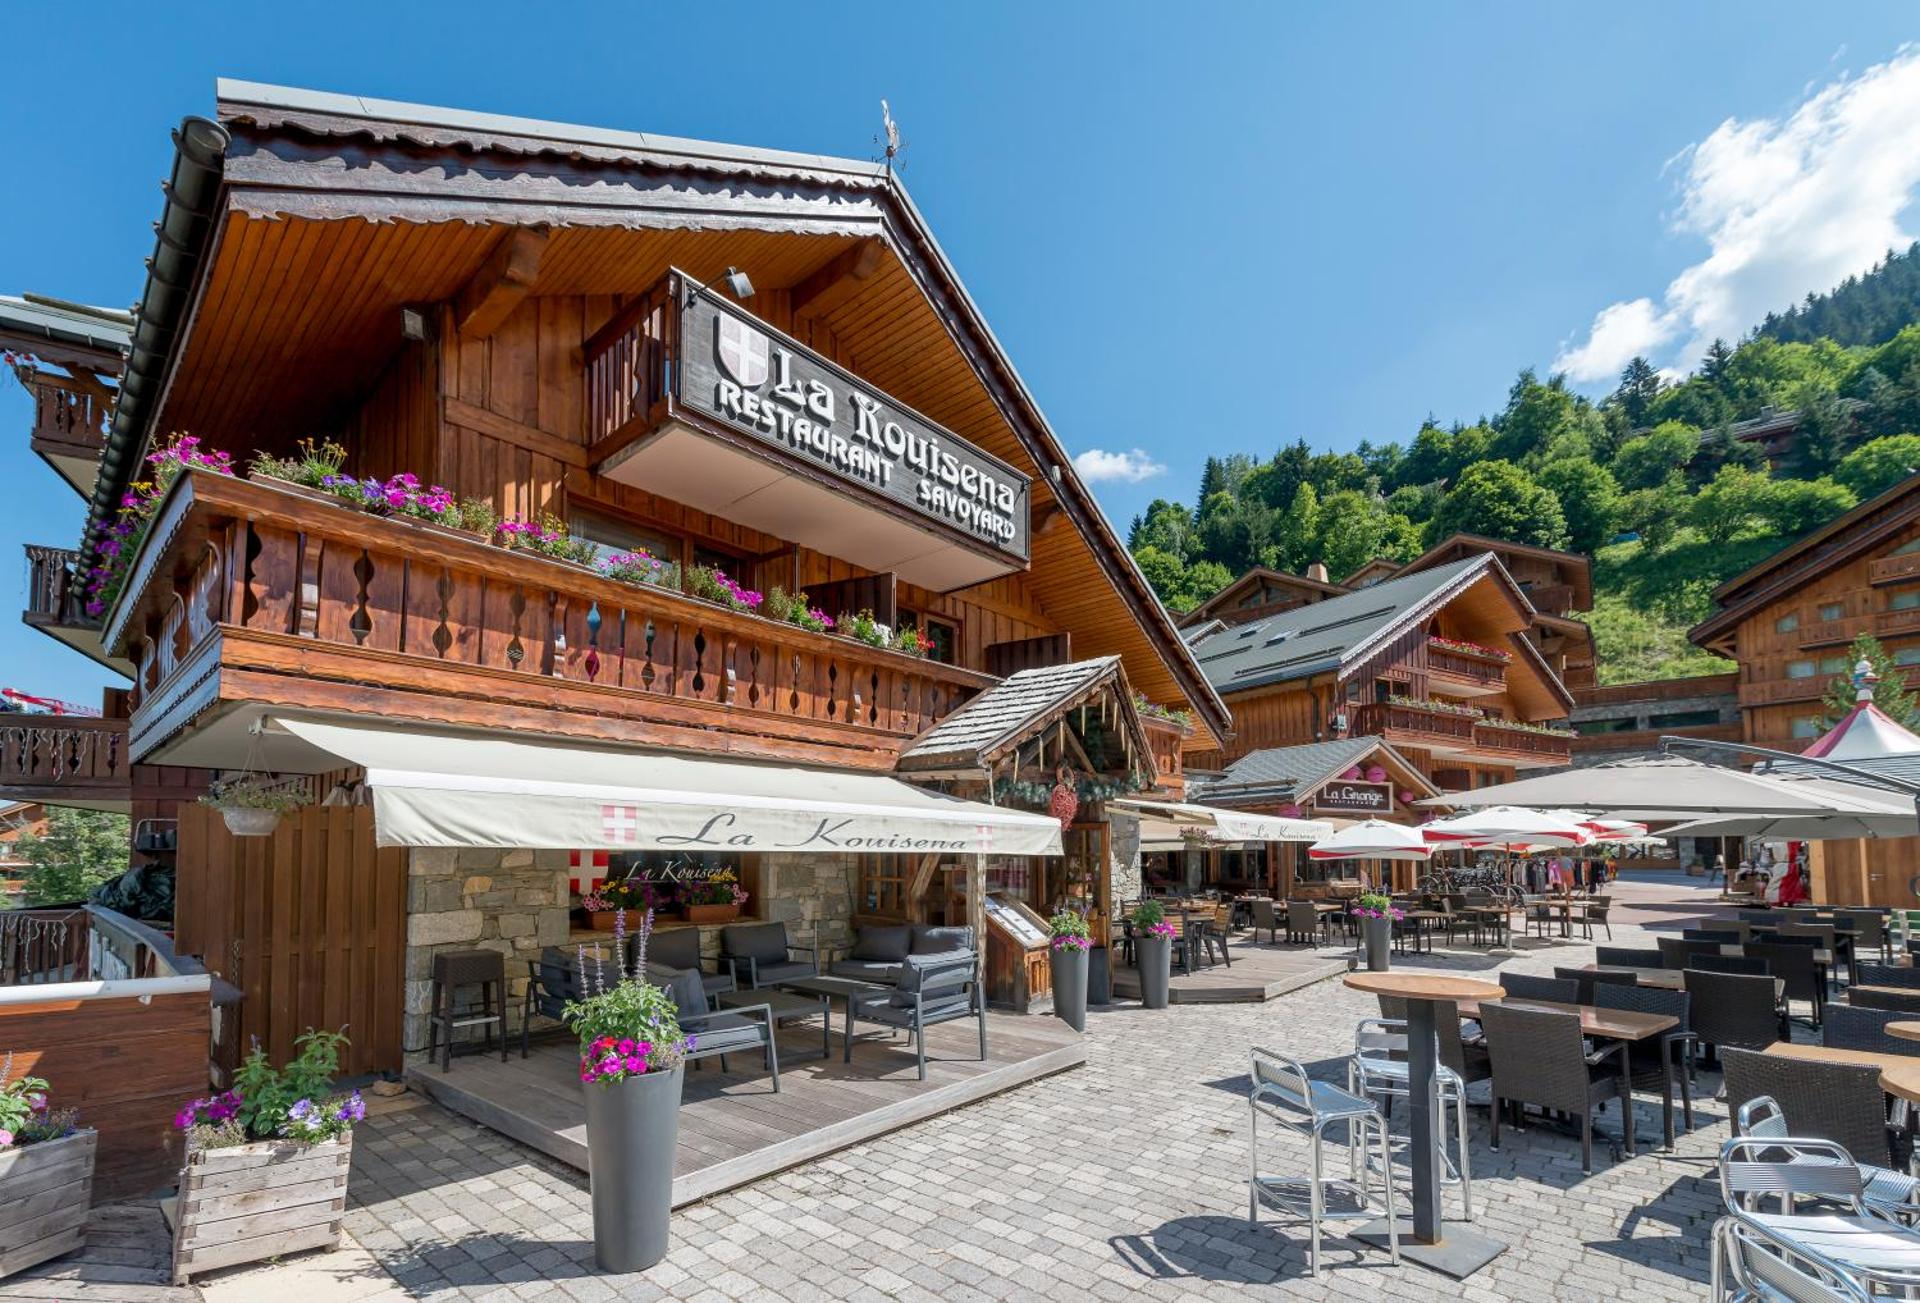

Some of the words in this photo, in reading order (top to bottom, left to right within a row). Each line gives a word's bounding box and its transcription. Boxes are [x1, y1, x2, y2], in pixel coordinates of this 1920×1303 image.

[719, 377, 894, 482] RESTAURANT
[774, 347, 836, 422] La
[853, 391, 1015, 514] Kouisena
[919, 478, 1016, 539] SAVOYARD
[1322, 784, 1339, 800] La
[655, 812, 756, 847] La
[773, 817, 967, 850] Kouisena
[1250, 823, 1269, 839] La
[624, 860, 656, 881] La
